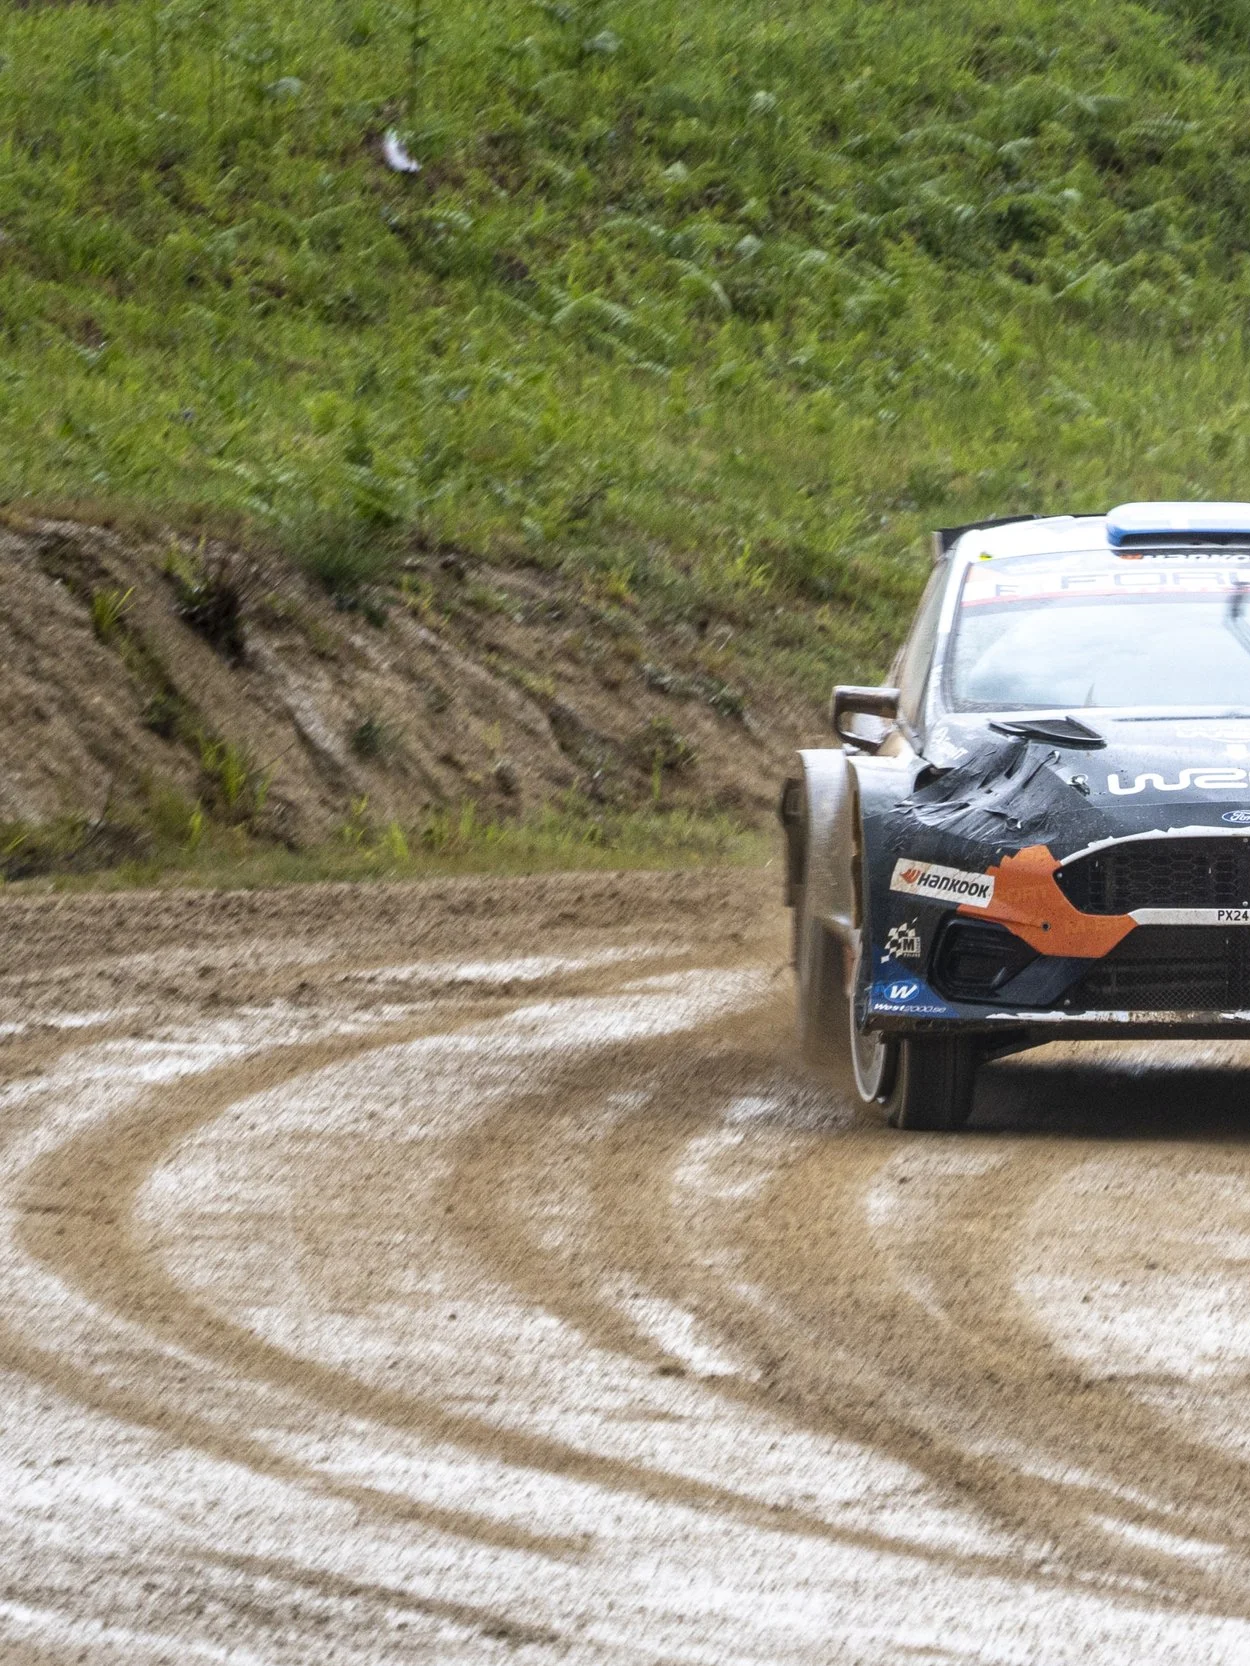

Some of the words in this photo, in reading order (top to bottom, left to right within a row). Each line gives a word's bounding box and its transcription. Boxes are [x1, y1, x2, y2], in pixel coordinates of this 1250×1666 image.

[917, 873, 990, 898] Hankook
[1217, 909, 1249, 922] PX24
[890, 984, 918, 999] W
